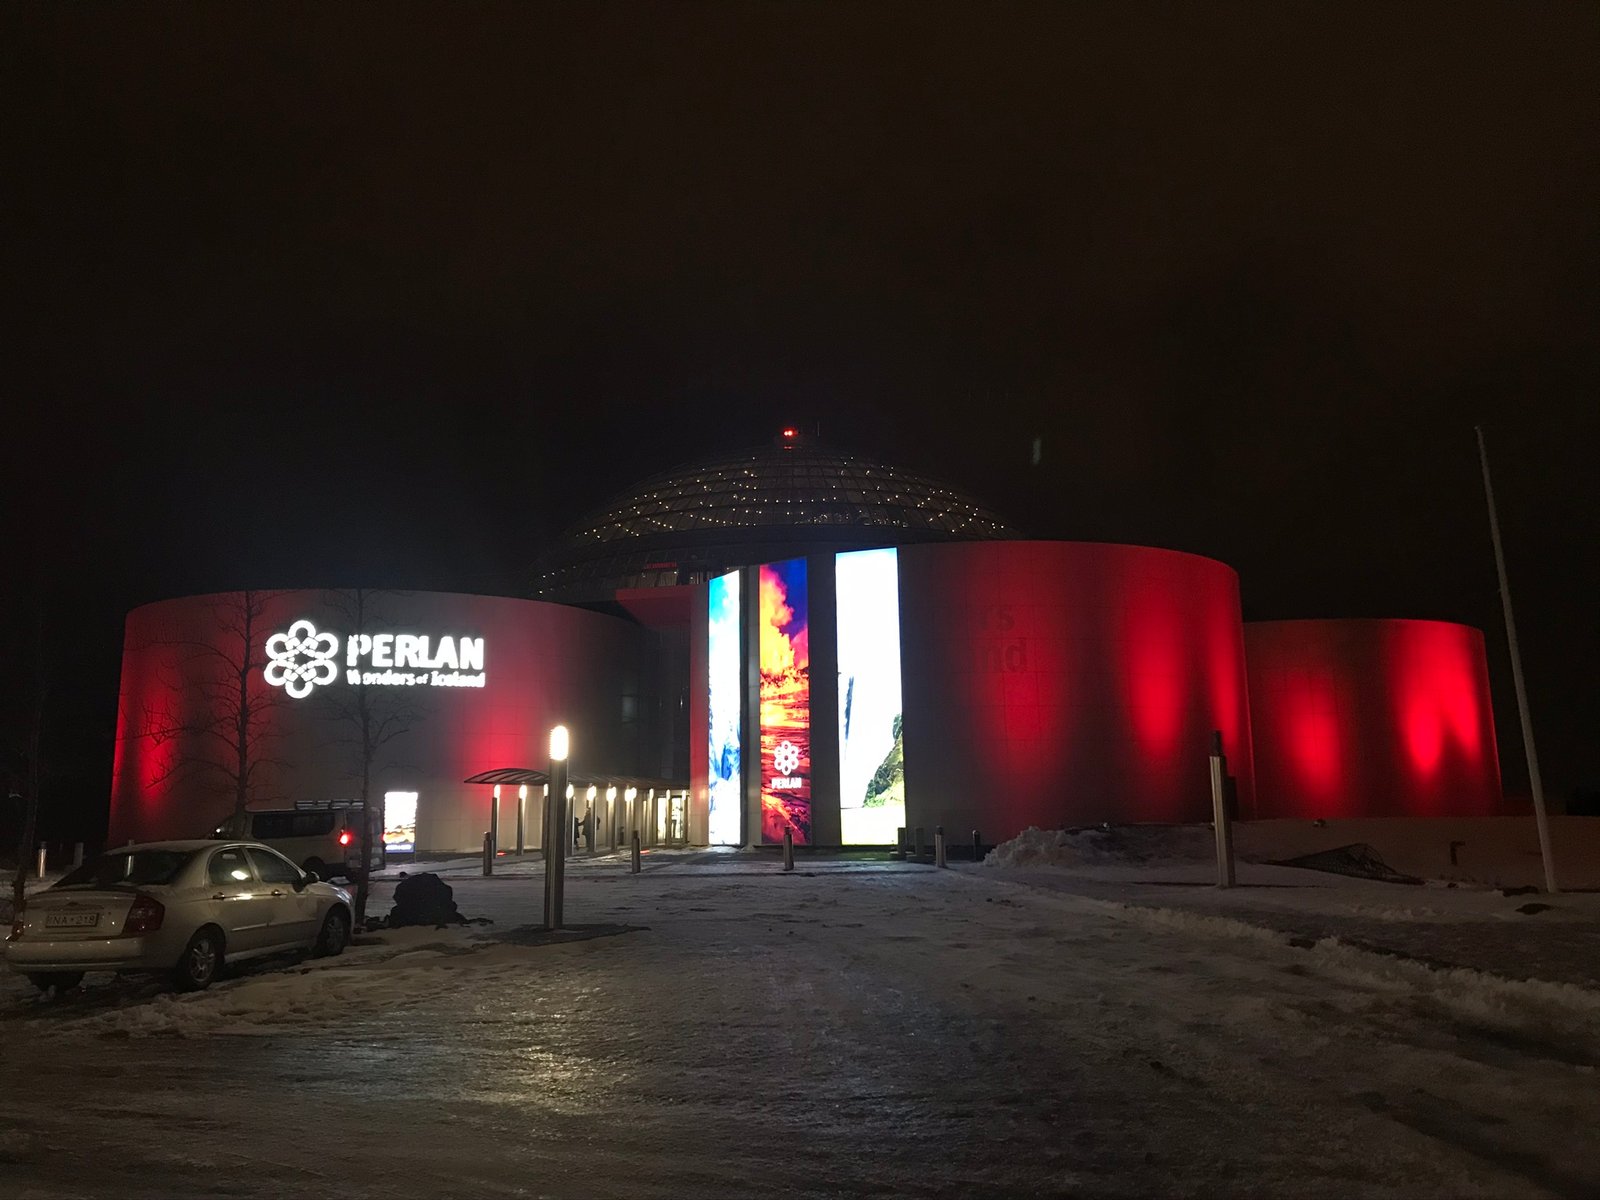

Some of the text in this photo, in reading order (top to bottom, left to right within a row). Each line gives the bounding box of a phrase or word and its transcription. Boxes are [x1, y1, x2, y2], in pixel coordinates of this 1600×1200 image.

[347, 634, 485, 670] PERLAN
[347, 669, 486, 687] Wonders of Iceland
[772, 777, 802, 790] PERLAN
